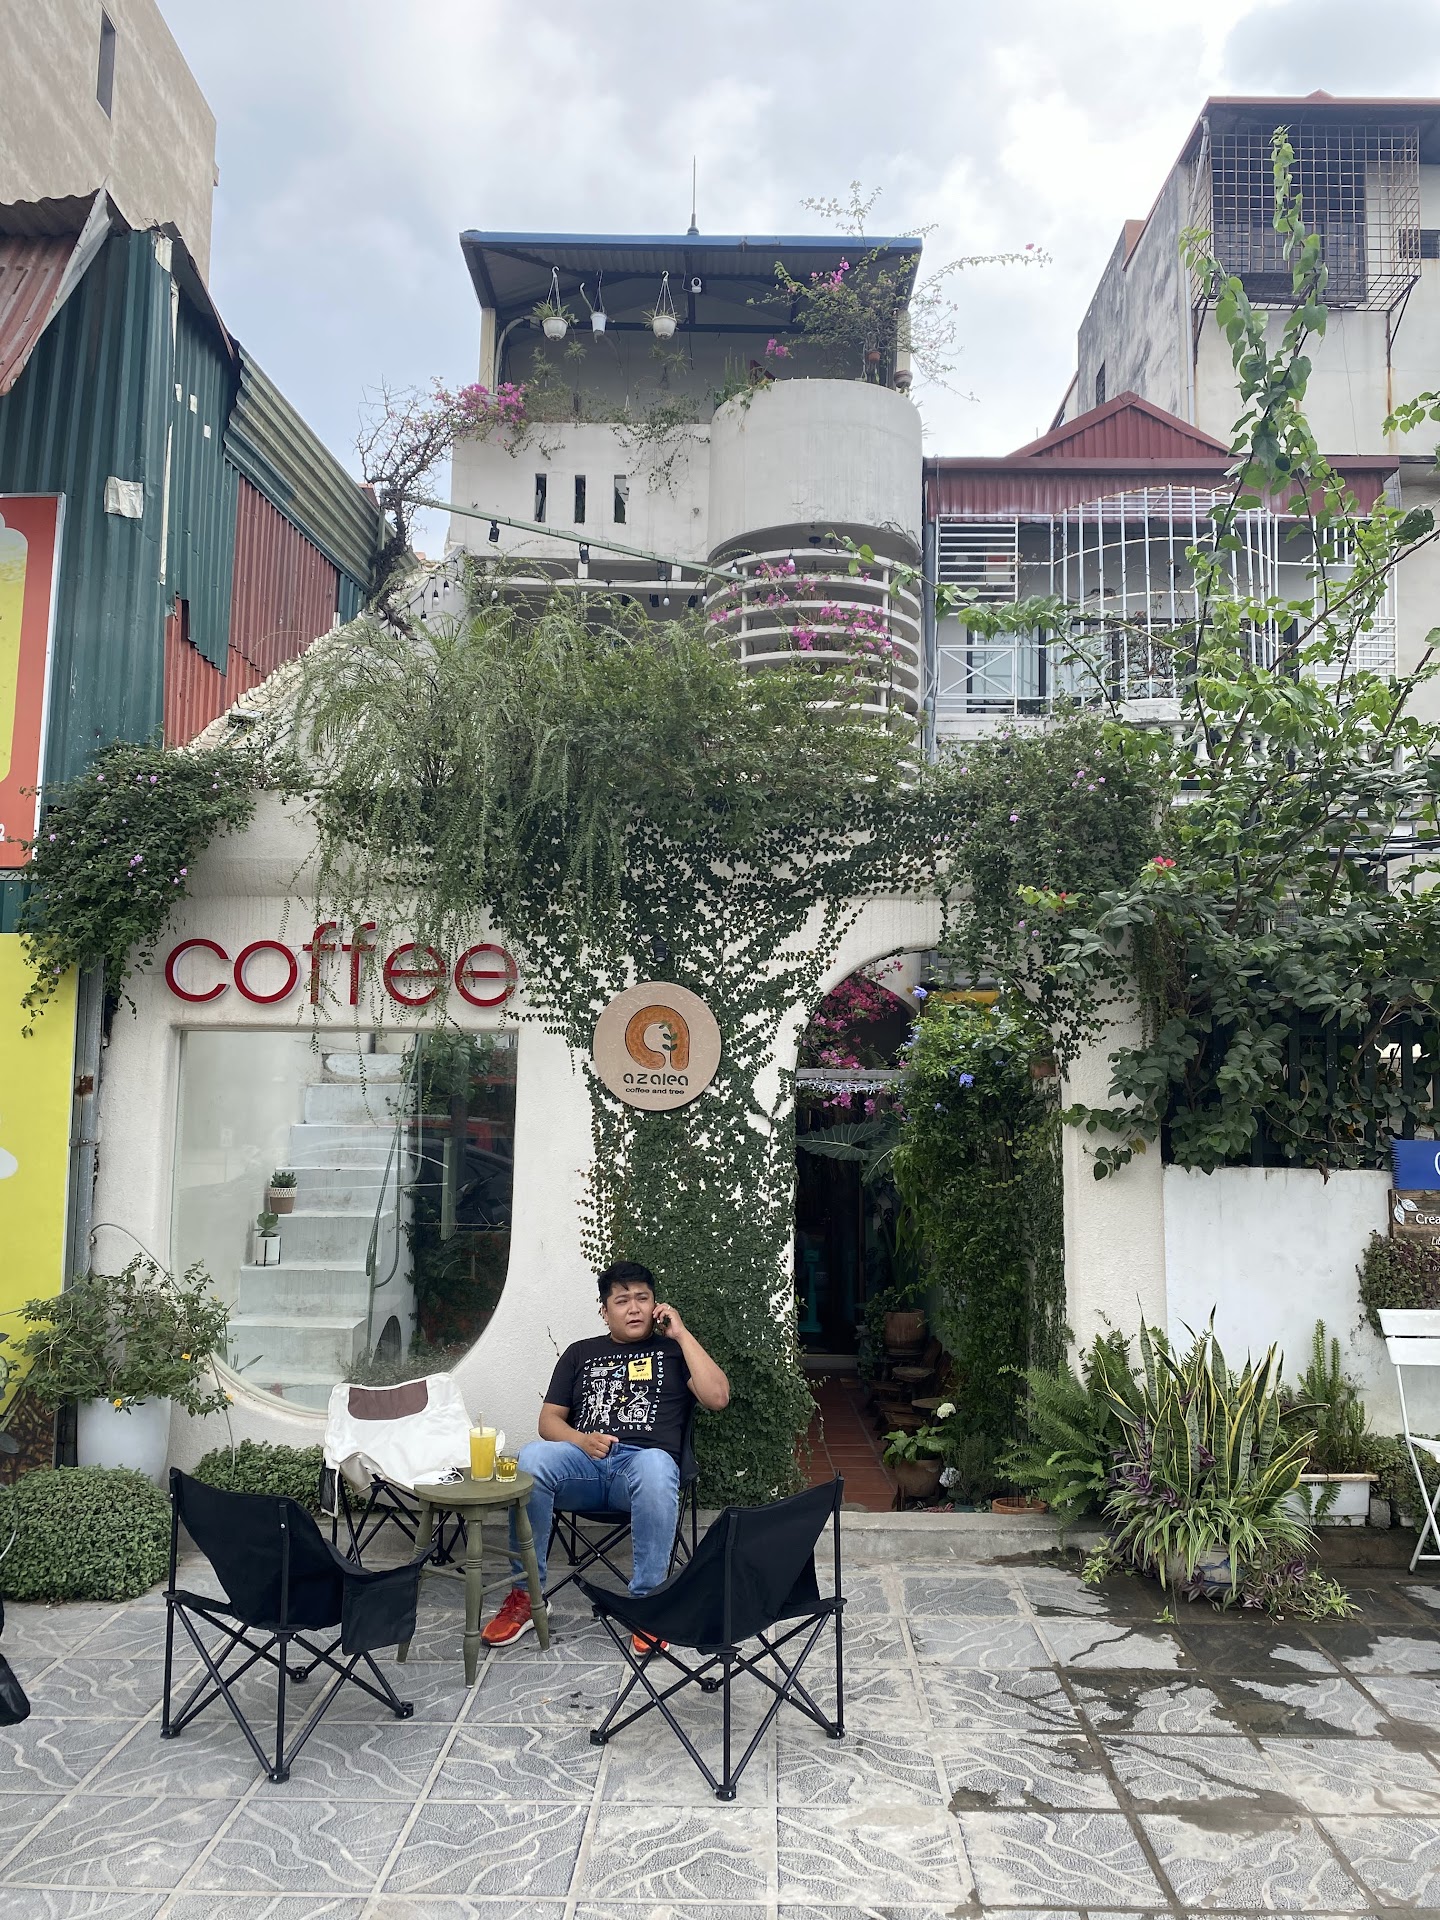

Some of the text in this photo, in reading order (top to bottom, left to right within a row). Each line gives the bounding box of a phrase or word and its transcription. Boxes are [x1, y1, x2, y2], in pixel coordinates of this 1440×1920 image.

[165, 921, 518, 1007] coffee
[623, 1073, 688, 1086] azalea
[628, 1351, 655, 1359] PARIS
[656, 1355, 665, 1393] LONDON
[611, 1424, 642, 1432] WIDE
